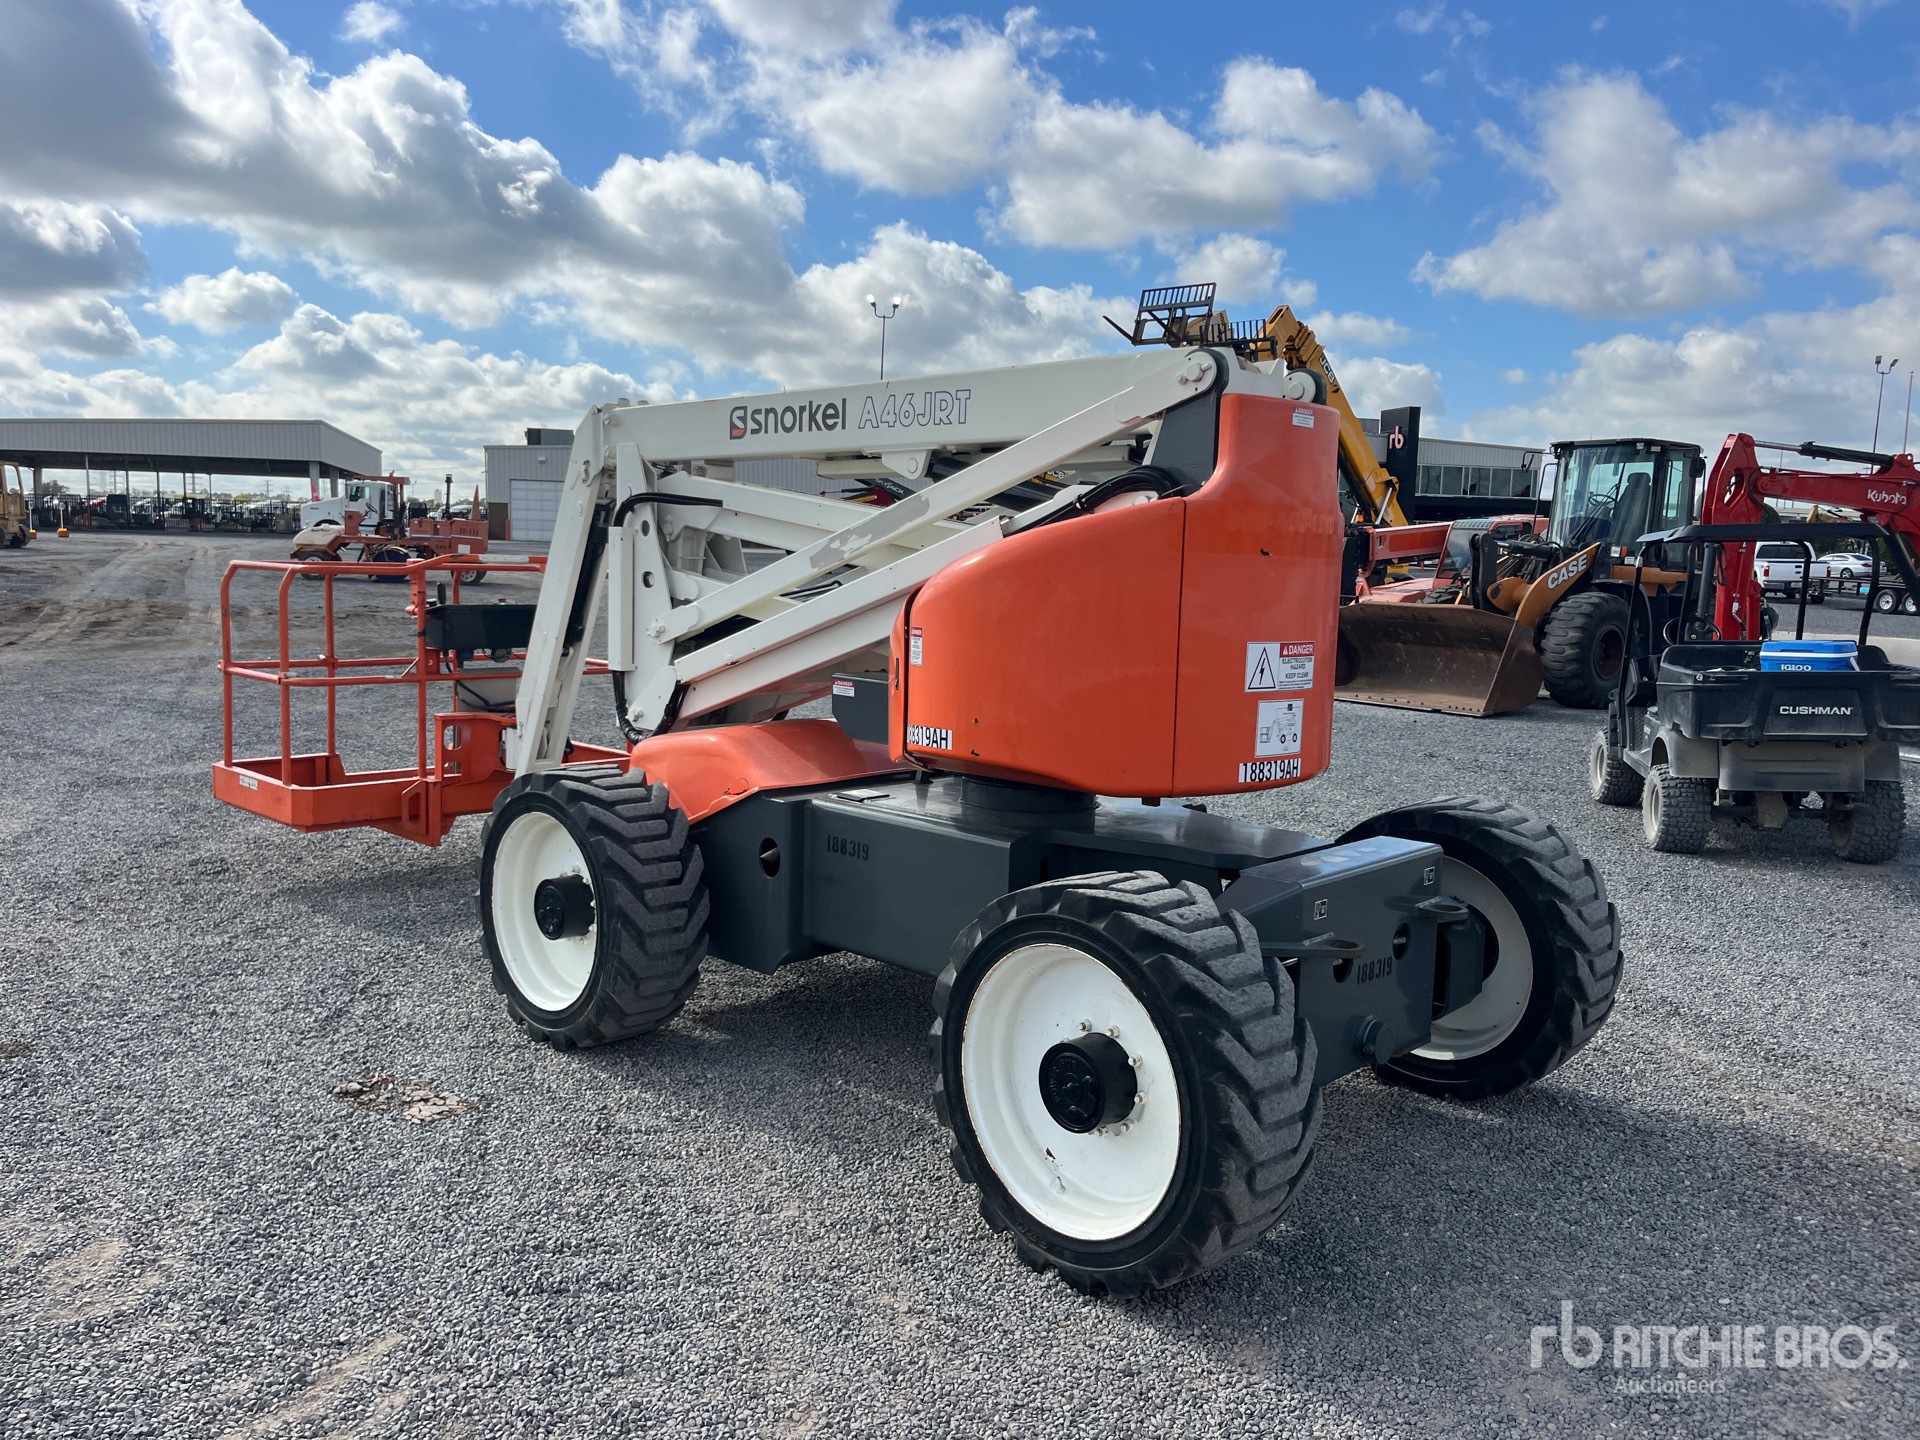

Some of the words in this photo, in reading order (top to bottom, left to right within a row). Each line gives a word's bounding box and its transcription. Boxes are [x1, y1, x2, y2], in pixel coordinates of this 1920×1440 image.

[1320, 356, 1335, 383] JCB
[750, 398, 847, 435] snorkel
[858, 389, 971, 429] A46JRT
[1389, 426, 1404, 449] rb
[1867, 489, 1907, 505] Kubota
[1547, 554, 1588, 589] CASE
[1289, 644, 1314, 655] DANGER
[1780, 706, 1851, 715] CUSHMAN
[1243, 758, 1299, 782] 188319AH
[827, 834, 869, 861] 188319
[1357, 956, 1393, 985] 188319
